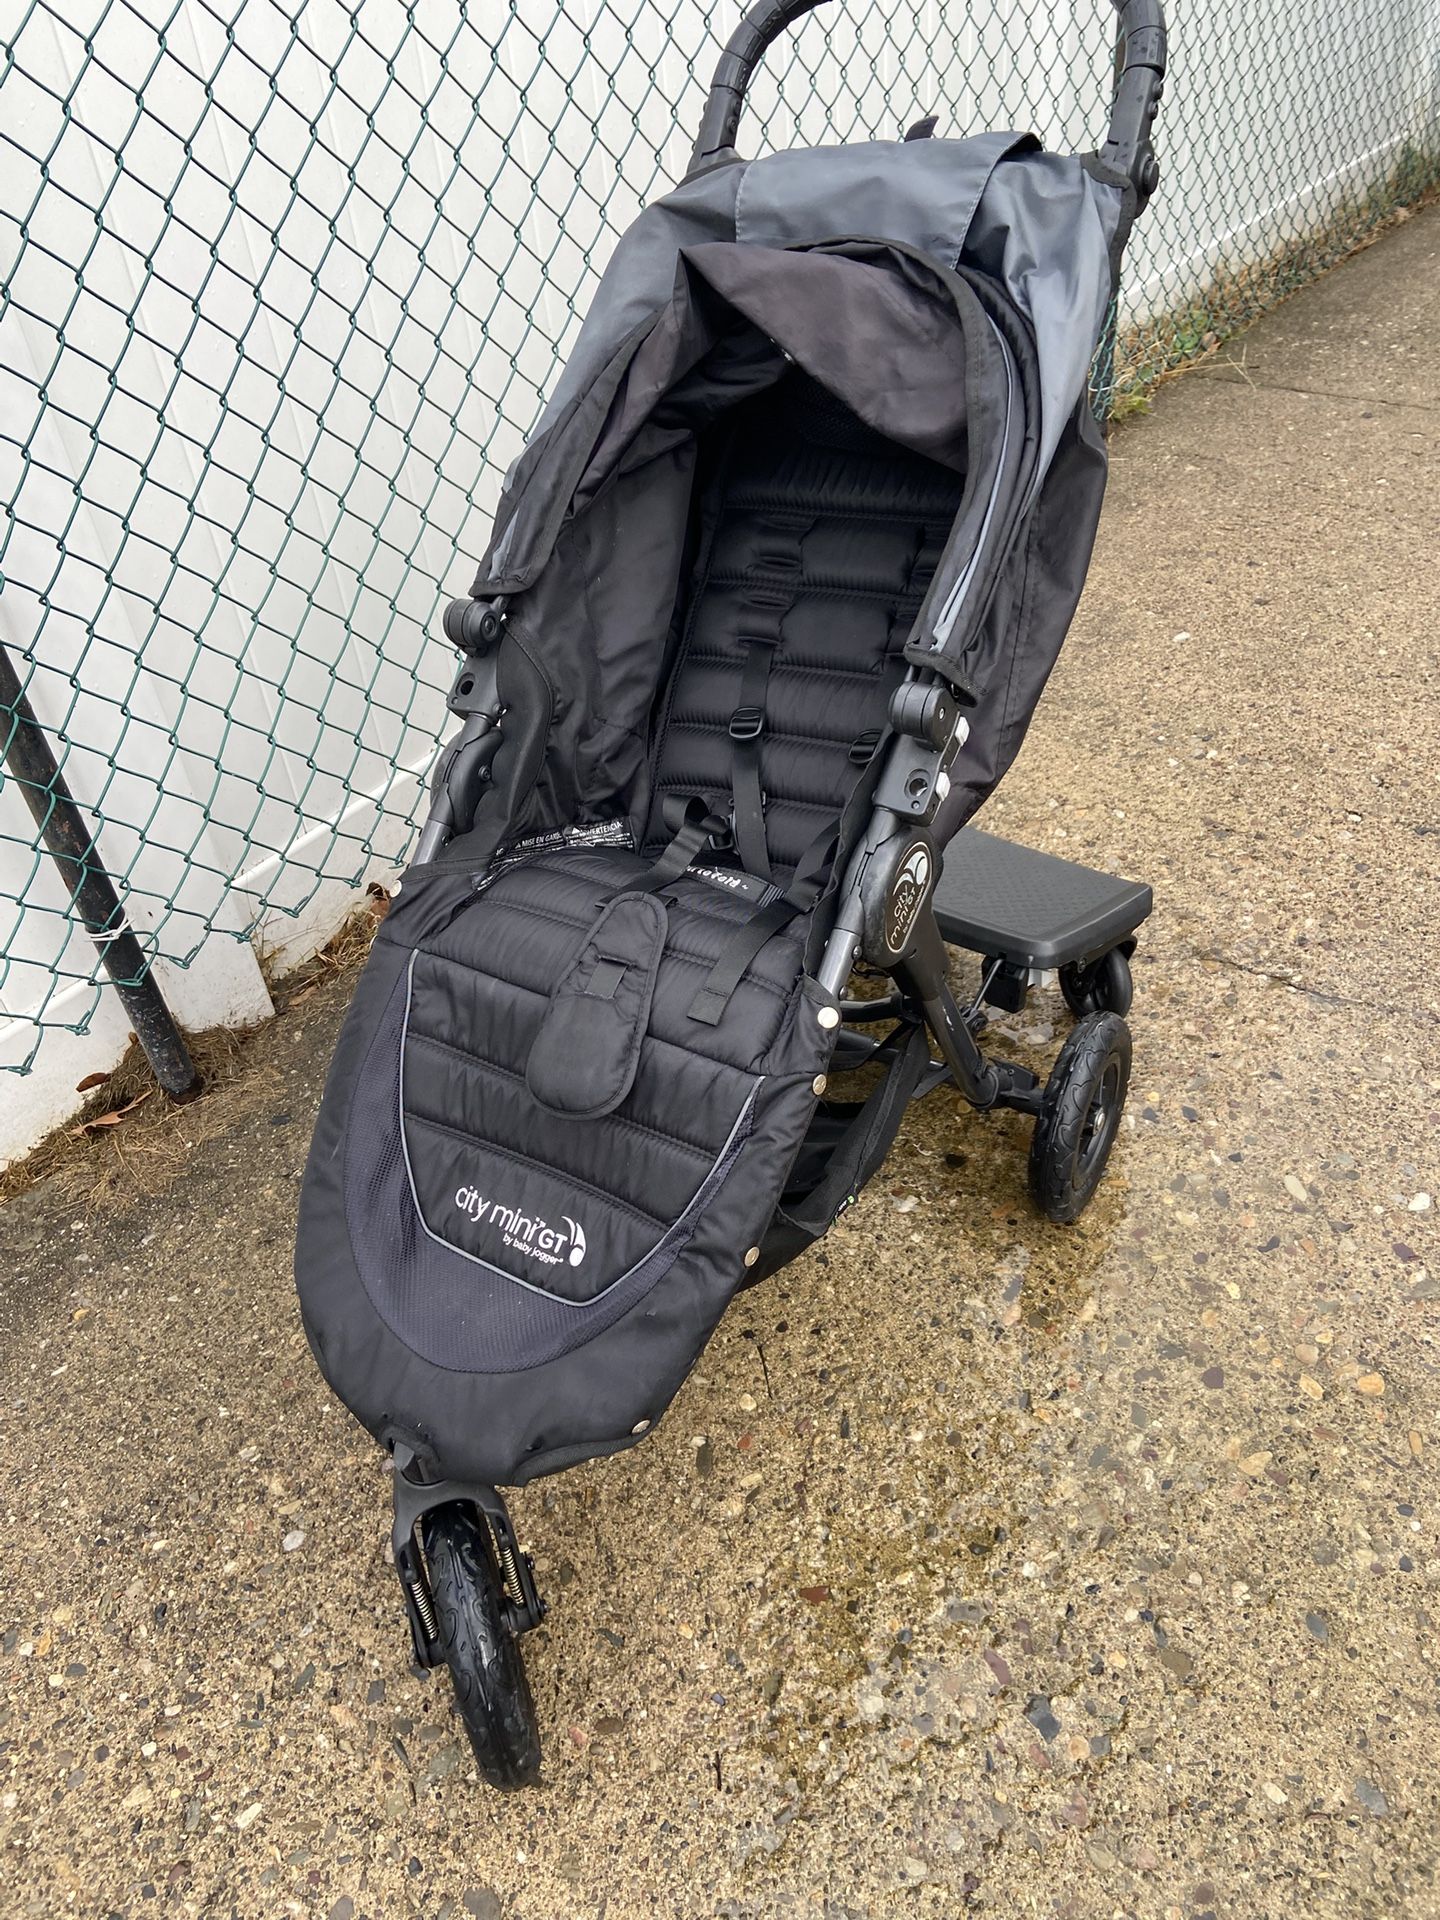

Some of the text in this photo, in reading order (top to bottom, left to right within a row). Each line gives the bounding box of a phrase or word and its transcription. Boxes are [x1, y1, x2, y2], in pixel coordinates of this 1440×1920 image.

[535, 835, 545, 844] EN
[894, 885, 909, 918] city
[891, 903, 909, 945] mini
[455, 1185, 491, 1222] city
[502, 1233, 559, 1265] by baby jogger
